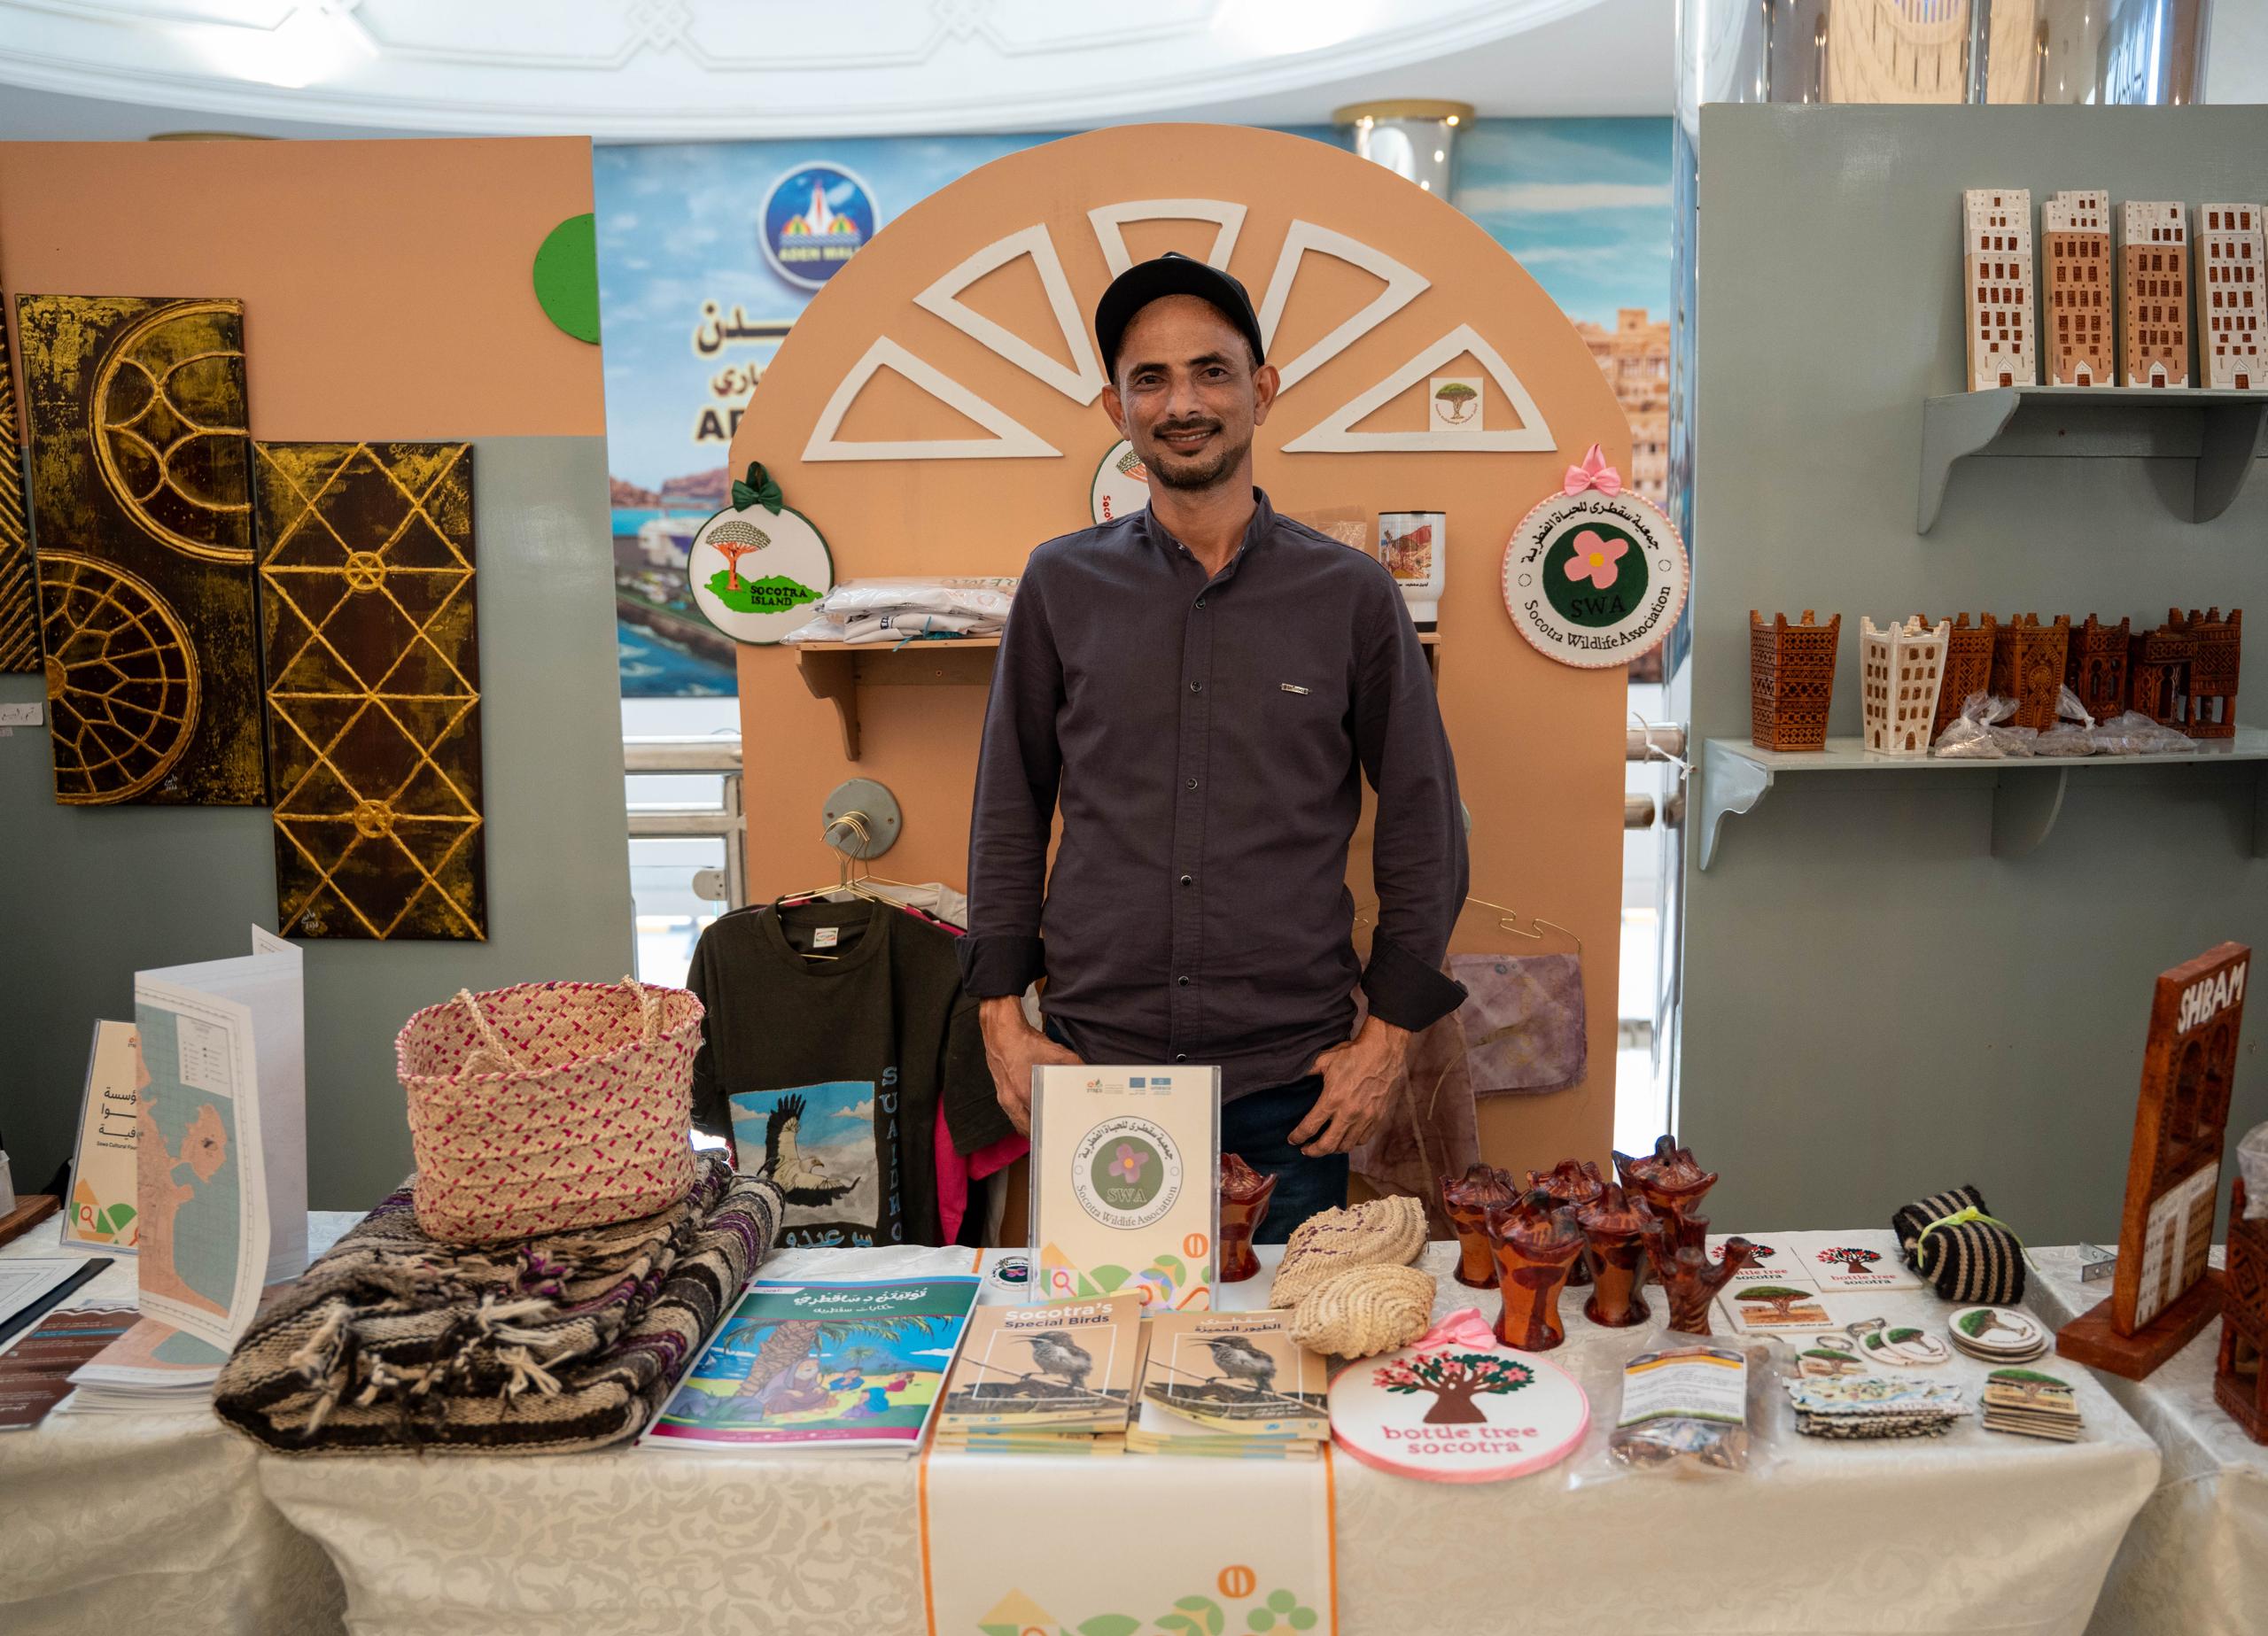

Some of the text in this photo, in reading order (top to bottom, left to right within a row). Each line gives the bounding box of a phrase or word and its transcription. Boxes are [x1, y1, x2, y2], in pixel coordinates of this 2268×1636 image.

[696, 302, 793, 353] دن
[1102, 495, 1115, 523] Soco
[1553, 500, 1588, 523] للحياة
[1589, 501, 1632, 521] سقطرى
[1631, 513, 1659, 550] جمعية
[750, 585, 808, 598] SOCOTRA
[750, 595, 793, 606] ISLAND
[1571, 595, 1627, 618] SWA
[1525, 585, 1671, 650] Socotra Wildlife Association
[2177, 961, 2247, 1035] SHBAM
[104, 1087, 136, 1105] ؤسسة
[1076, 1184, 1177, 1227] Socotra Wildlife Association
[1107, 1188, 1147, 1203] SWA
[1005, 1315, 1110, 1329] Special Birds
[1242, 1323, 1281, 1332] الطيور
[1381, 1424, 1539, 1439] bottle tree
[1408, 1441, 1522, 1454] socotra
